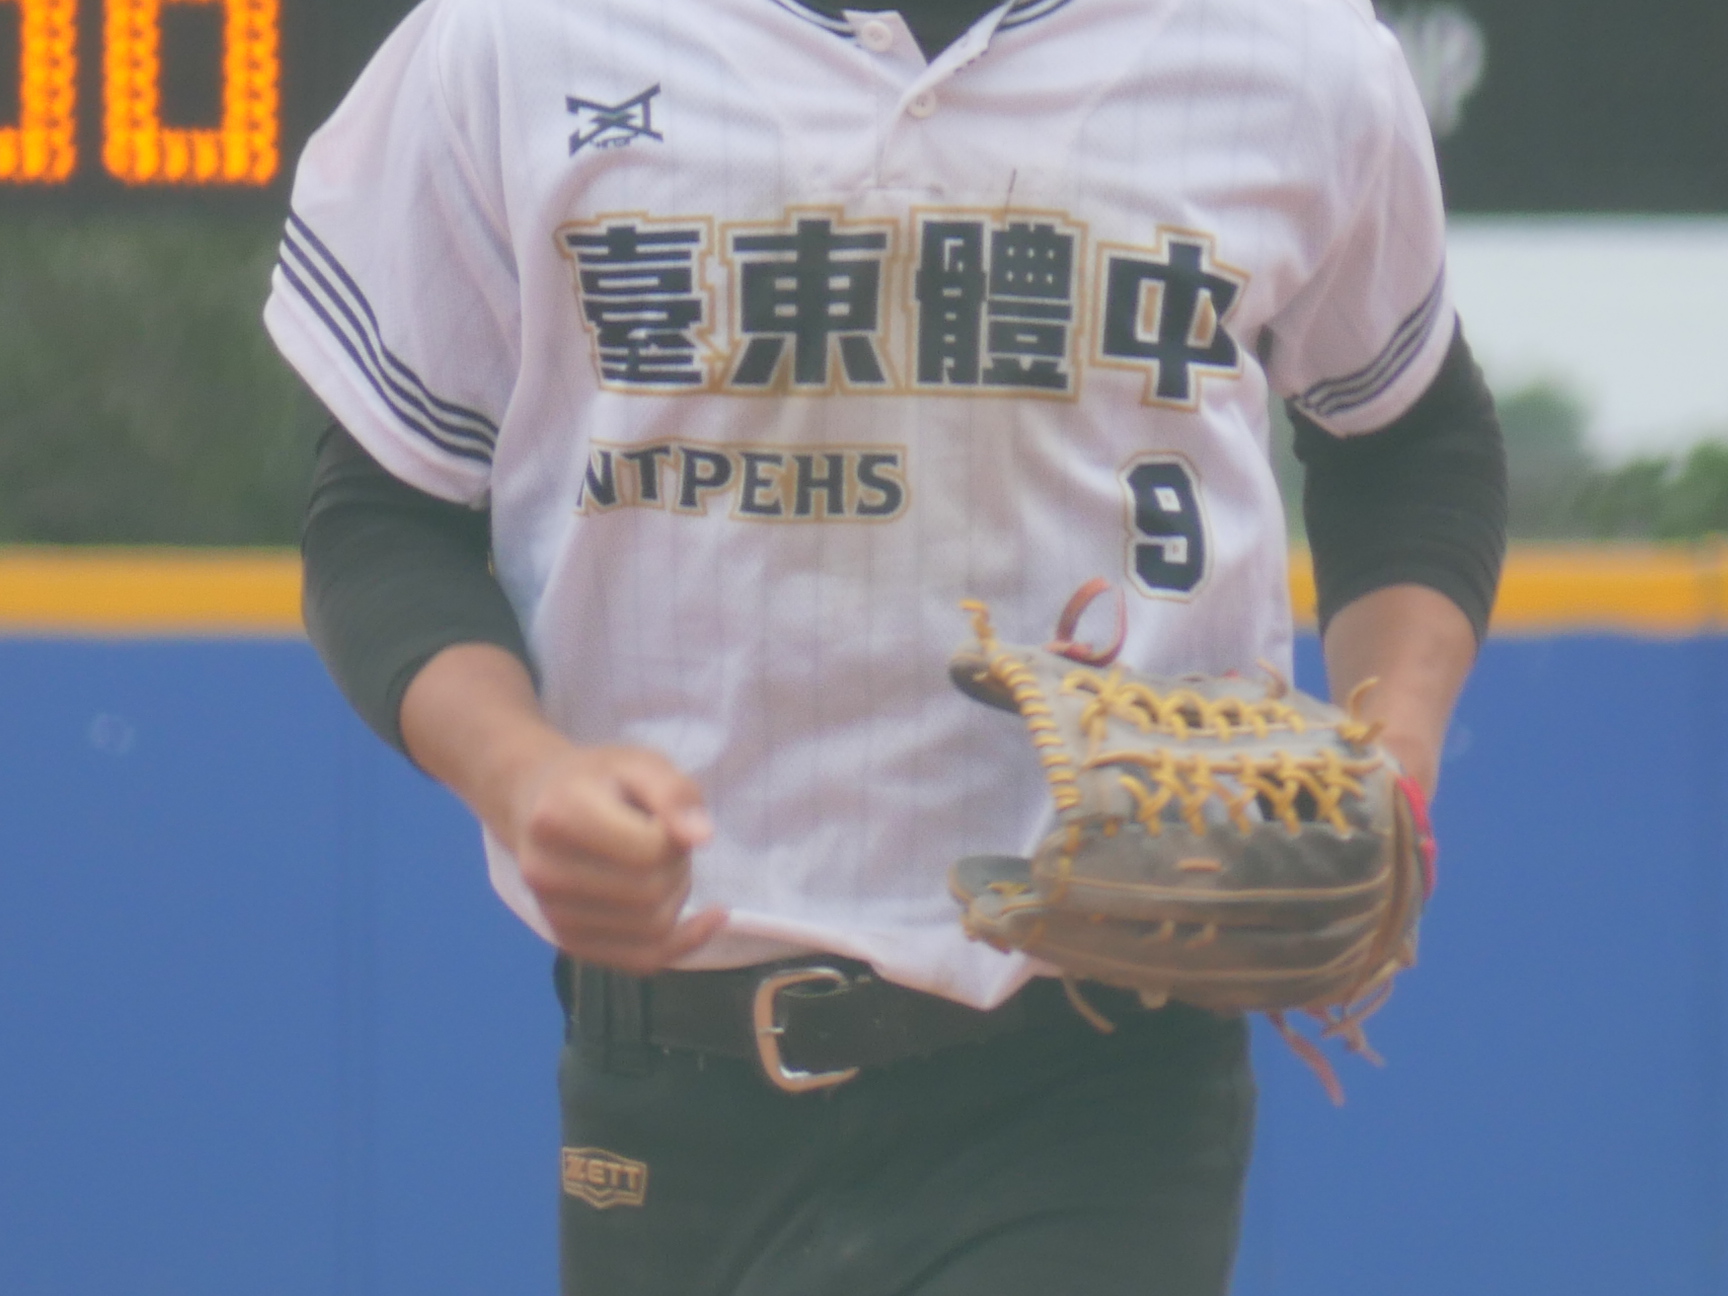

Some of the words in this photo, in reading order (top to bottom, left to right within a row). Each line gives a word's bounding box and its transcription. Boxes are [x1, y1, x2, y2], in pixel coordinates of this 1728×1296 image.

[560, 212, 1247, 405] 臺東體中
[574, 442, 908, 520] NTPEHS
[1124, 457, 1210, 596] 9
